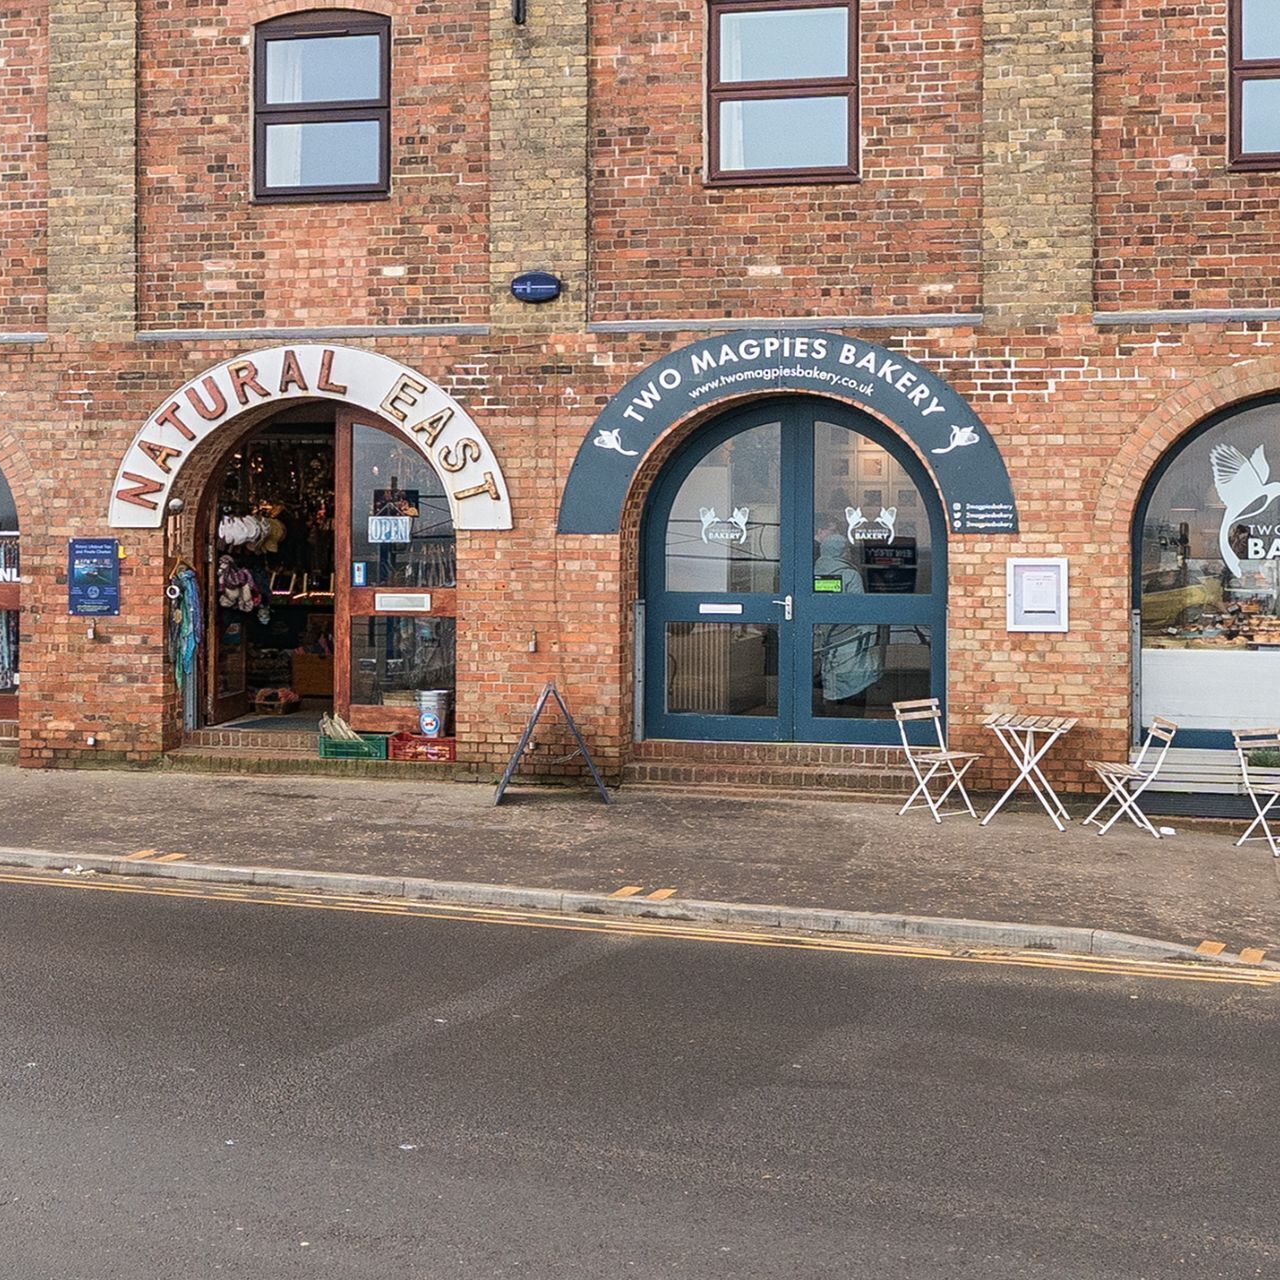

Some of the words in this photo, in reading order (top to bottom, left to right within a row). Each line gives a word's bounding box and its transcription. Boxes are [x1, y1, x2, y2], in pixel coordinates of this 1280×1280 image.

[623, 368, 681, 423] TWO
[690, 336, 828, 375] MAGPIES
[838, 343, 946, 417] BAKERY
[688, 364, 875, 399] www.twomagpiesbakery.co.uk
[116, 349, 348, 511] NATURAL
[379, 372, 501, 501] EAST
[371, 518, 407, 541] OPEN
[709, 532, 741, 540] BAKERY
